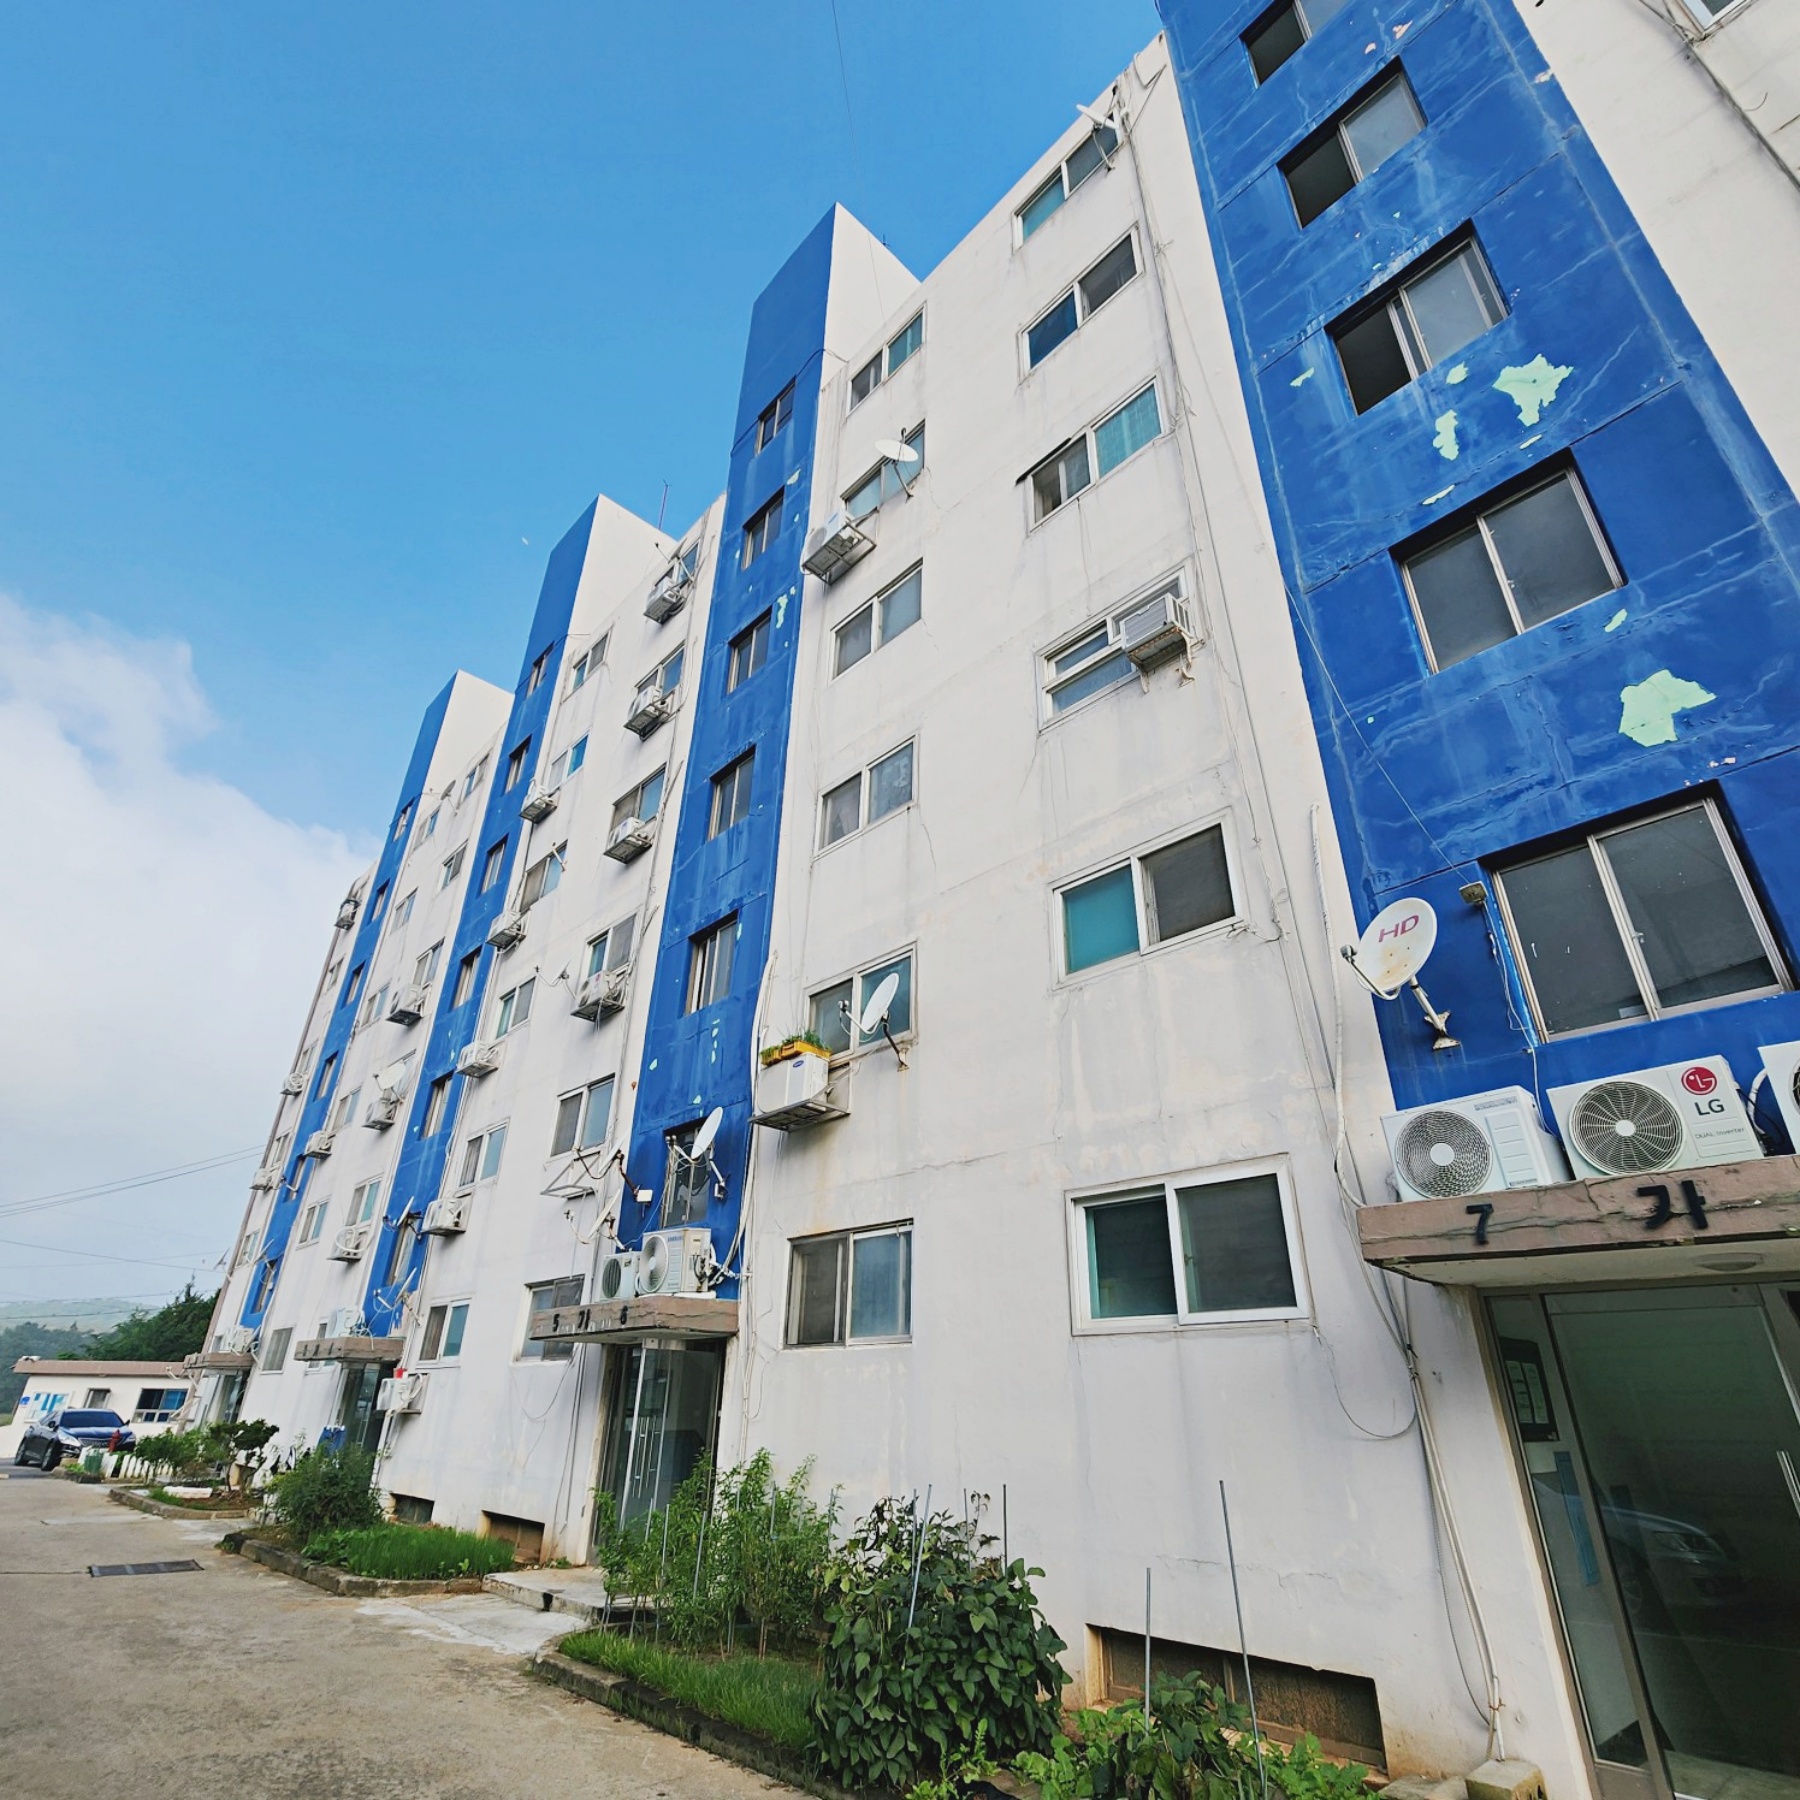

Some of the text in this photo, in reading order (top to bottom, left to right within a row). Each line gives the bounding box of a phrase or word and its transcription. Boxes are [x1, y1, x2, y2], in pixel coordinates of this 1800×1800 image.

[1379, 915, 1419, 943] HD
[1694, 1098, 1725, 1116] LG
[1466, 1179, 1709, 1246] 7 가
[552, 1313, 560, 1333] 5
[620, 1305, 629, 1325] 6
